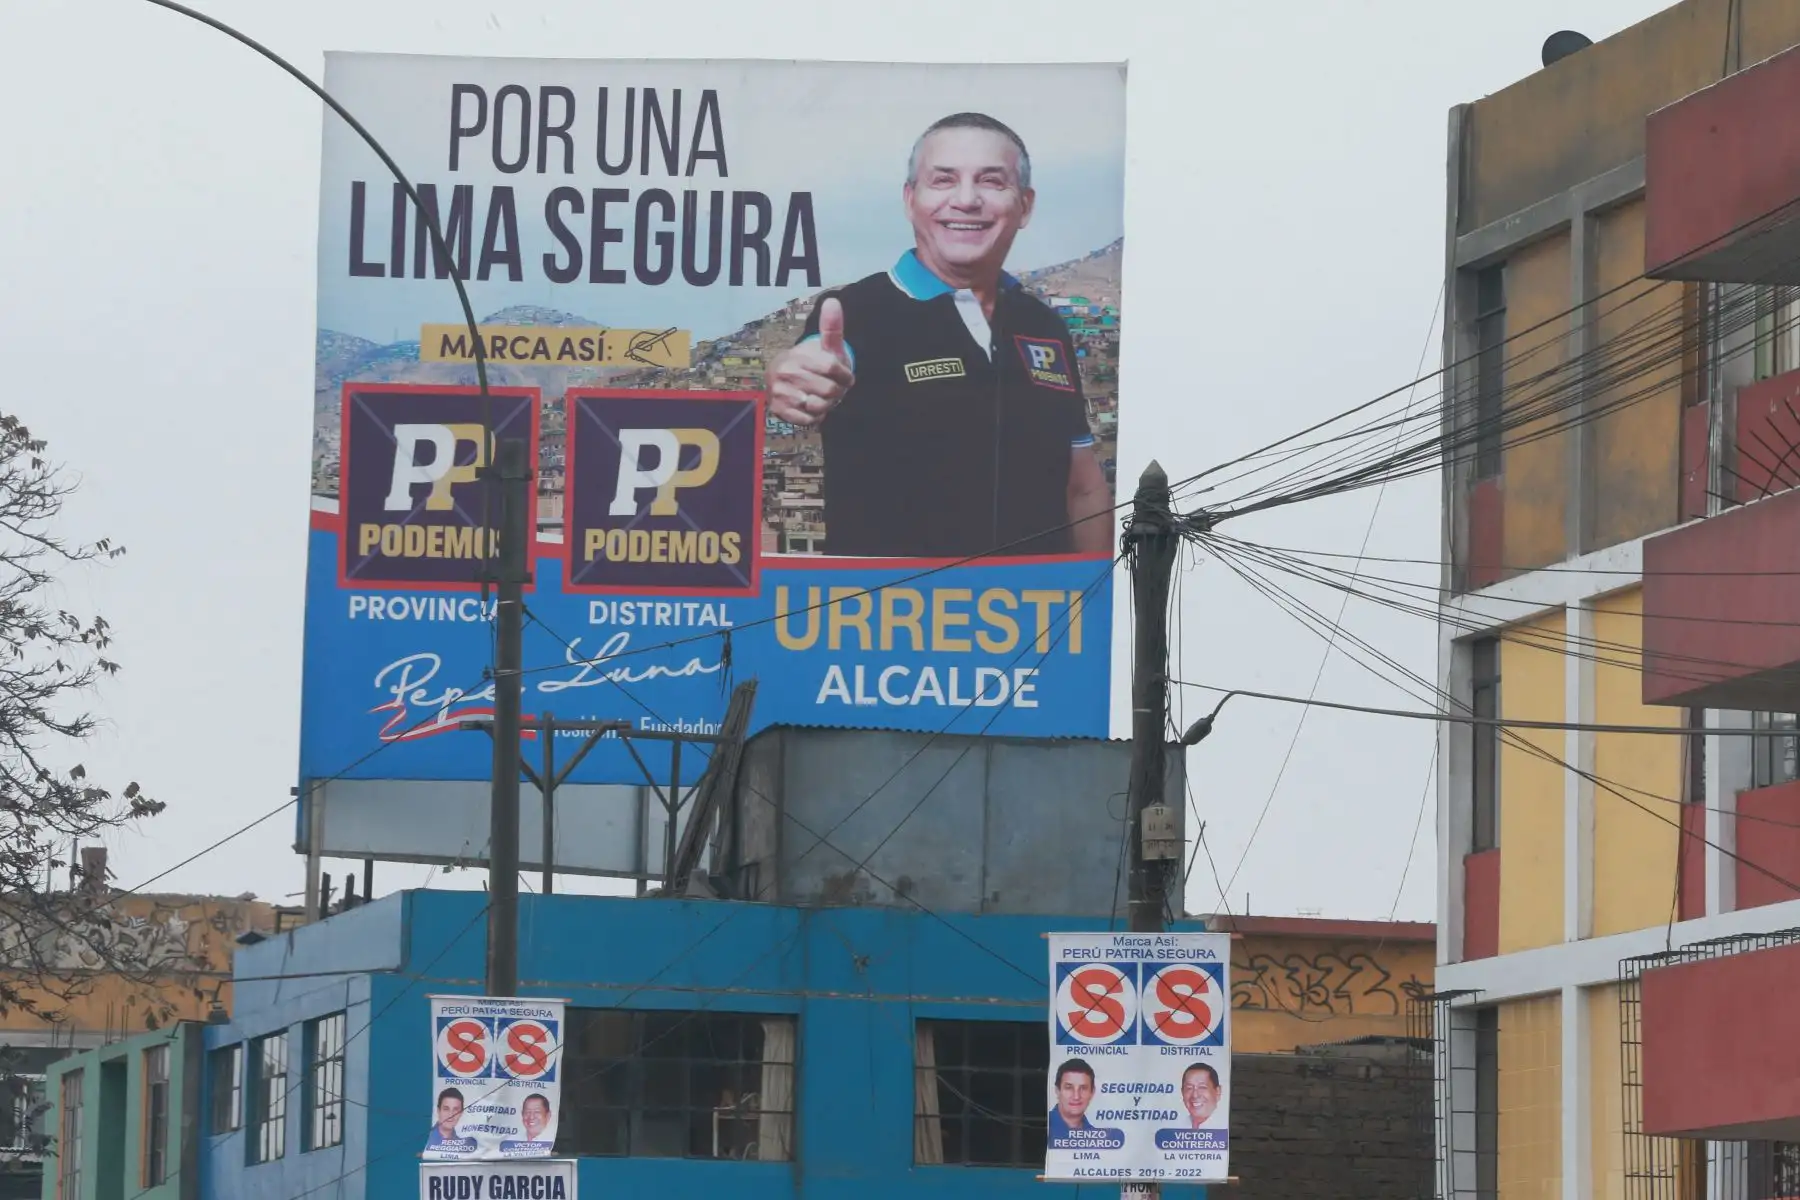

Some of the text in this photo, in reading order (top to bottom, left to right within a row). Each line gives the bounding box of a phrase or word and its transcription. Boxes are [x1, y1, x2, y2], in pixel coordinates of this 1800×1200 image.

[449, 83, 728, 177] POR UNA
[349, 180, 821, 287] LIMA SEGURA
[440, 331, 613, 362] MARCA ASÍ:
[910, 362, 961, 379] URRESTI
[359, 523, 500, 560] PODEMO
[584, 528, 741, 564] PODEMOS
[589, 600, 733, 627] DISTRITAL
[774, 586, 1082, 654] URRESTI
[538, 632, 723, 692] Luna
[815, 665, 1040, 708] ALCALDE
[1113, 936, 1151, 947] Marca
[1062, 947, 1216, 959] PERÚ PATRIA SEGURA
[1068, 968, 1125, 1039] S
[1153, 969, 1212, 1039] S
[441, 1005, 553, 1018] PERÚ PATRIA SEGURA
[446, 1021, 547, 1075] S S
[1067, 1046, 1213, 1056] PROVINCIAL DISTRITAL
[445, 1078, 547, 1089] PROVINCIAL DISTRITAL
[1100, 1083, 1174, 1094] SEGURIDAD
[1133, 1097, 1141, 1106] Y
[467, 1105, 517, 1115] SEGURIDAD
[1095, 1110, 1178, 1121] HONESTIDAD
[461, 1125, 518, 1135] HONESTIDAD
[1068, 1130, 1107, 1139] RENZO
[1174, 1132, 1213, 1141] VICTOR
[1054, 1139, 1121, 1148] REGGIARDO
[1161, 1140, 1226, 1149] CONTRERAS
[1073, 1152, 1100, 1161] LIMA
[1164, 1153, 1222, 1161] LA VICTORIA
[1073, 1168, 1132, 1177] ALCALDES
[1138, 1168, 1165, 1177] 2019
[1175, 1168, 1202, 1177] 2022
[429, 1174, 566, 1200] RUDY GARCIA
